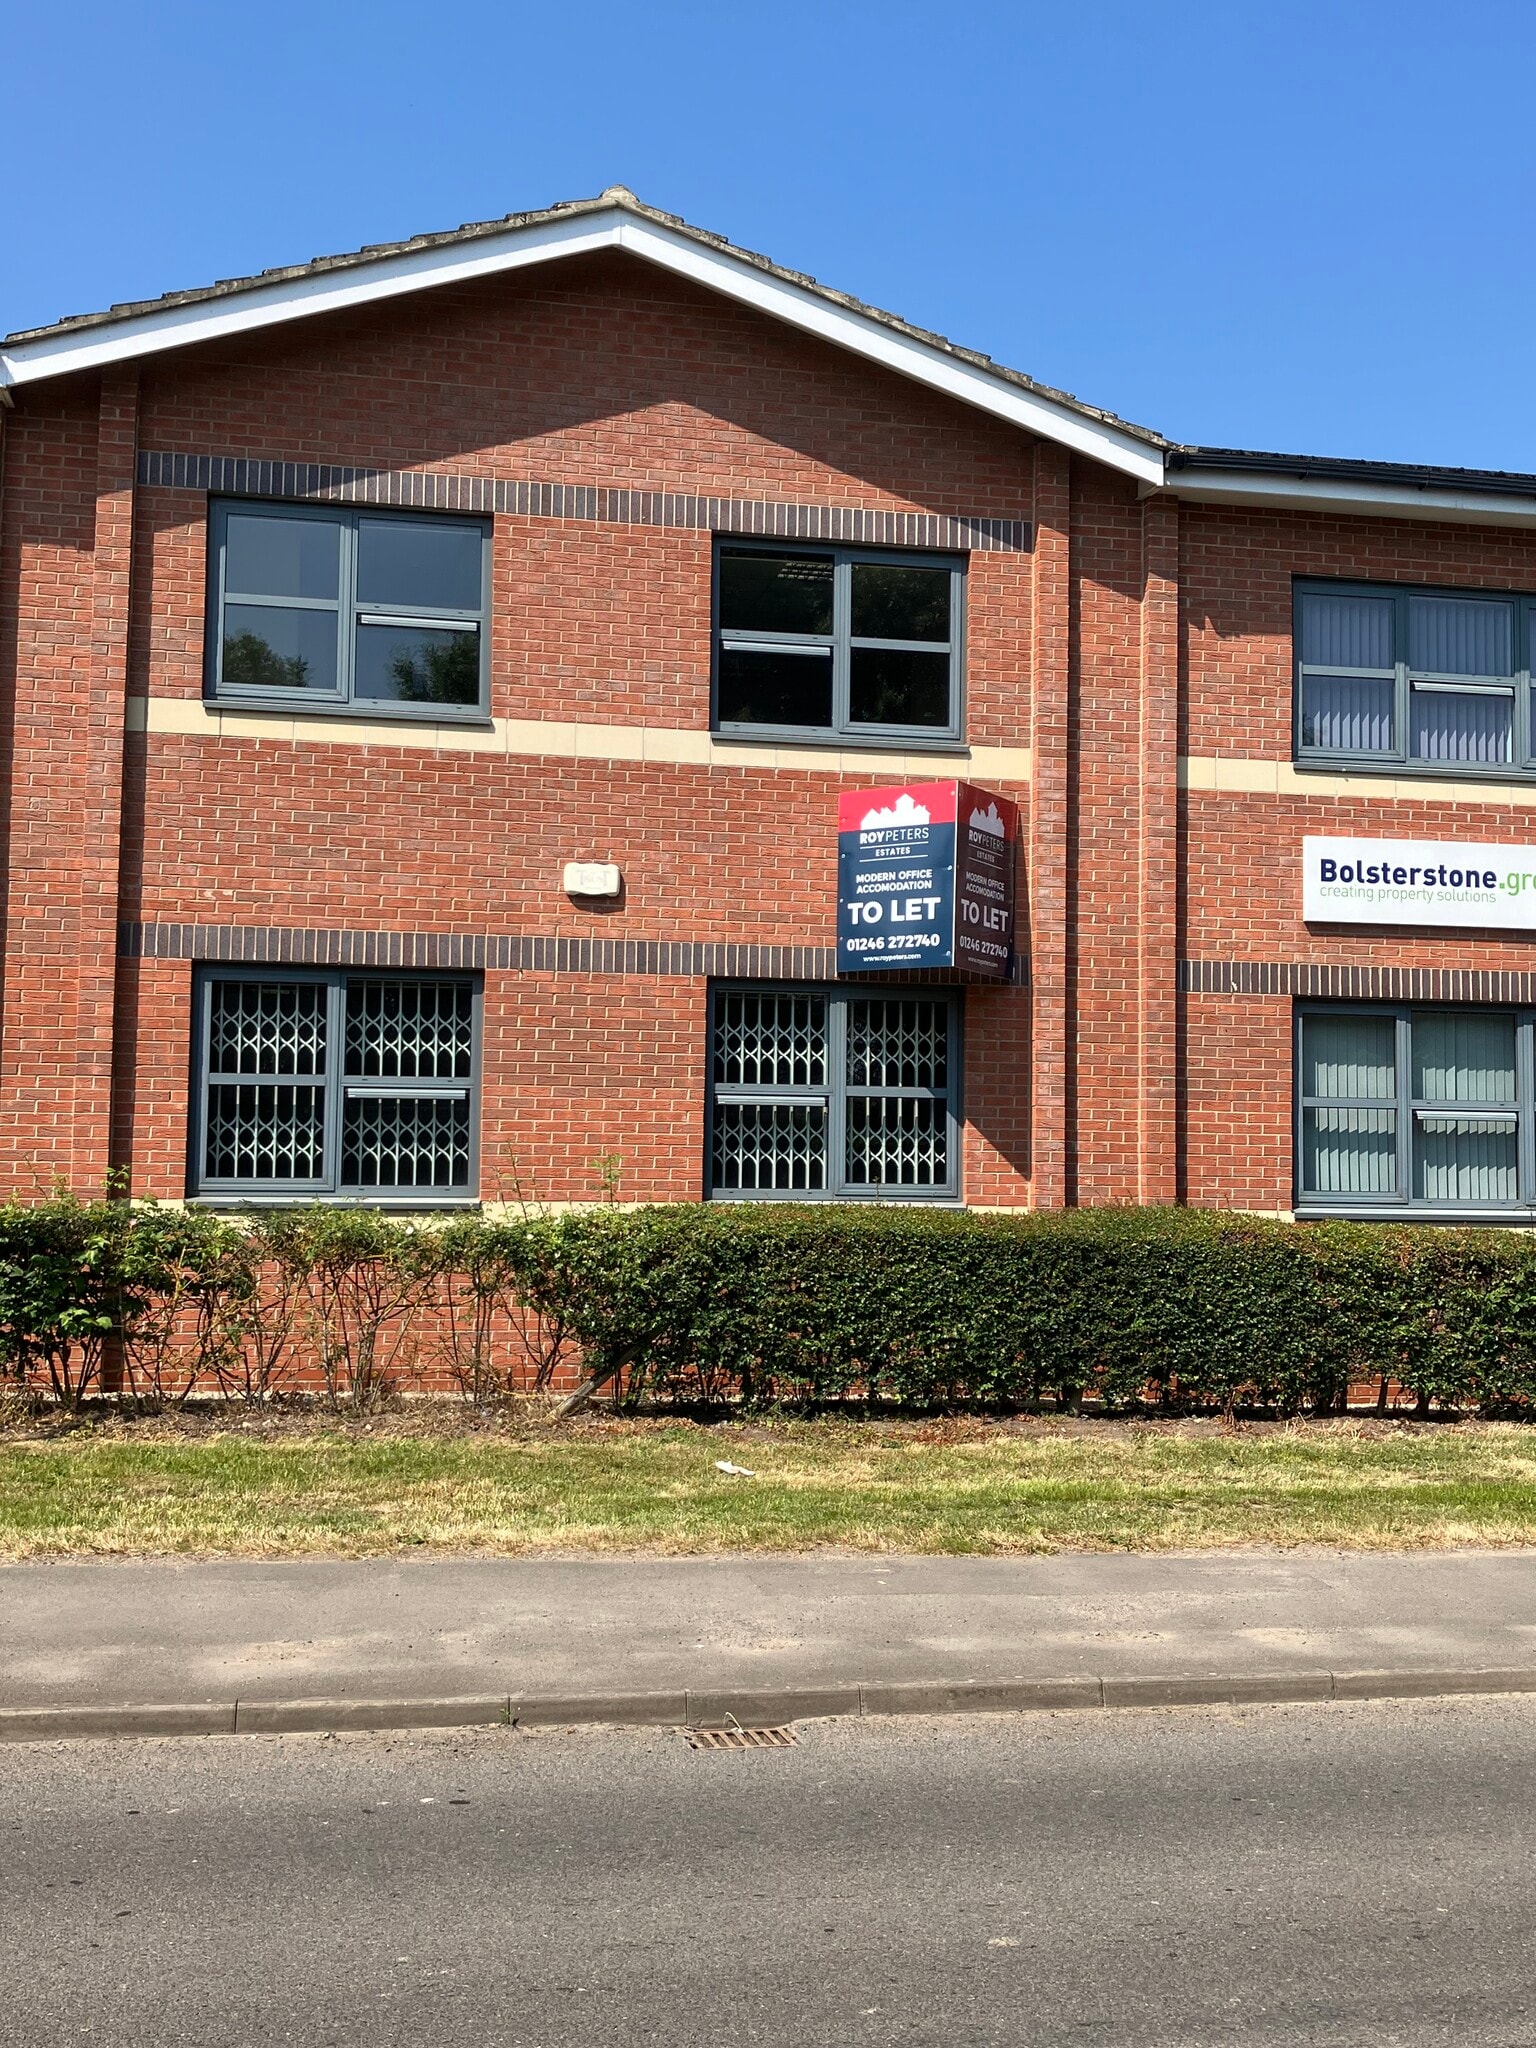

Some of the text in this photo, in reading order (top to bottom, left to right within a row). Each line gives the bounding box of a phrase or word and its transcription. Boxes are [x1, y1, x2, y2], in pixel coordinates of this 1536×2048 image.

[875, 847, 911, 857] ESTATES
[976, 851, 995, 863] ESTATES
[856, 869, 933, 884] MODERN OFFICE
[966, 871, 1005, 891] MODERN OFFICE
[1320, 858, 1536, 896] Bolsterstone.gr
[856, 880, 932, 894] ACCOMODATION
[966, 882, 1005, 902] ACCOMODATION
[1320, 885, 1497, 904] creating property solutions
[847, 897, 941, 925] TO LET
[961, 898, 1009, 932] TO LET
[846, 933, 941, 952] 01246 272740
[959, 935, 1008, 959] 01246 272740
[863, 953, 922, 963] www.roypeters.com
